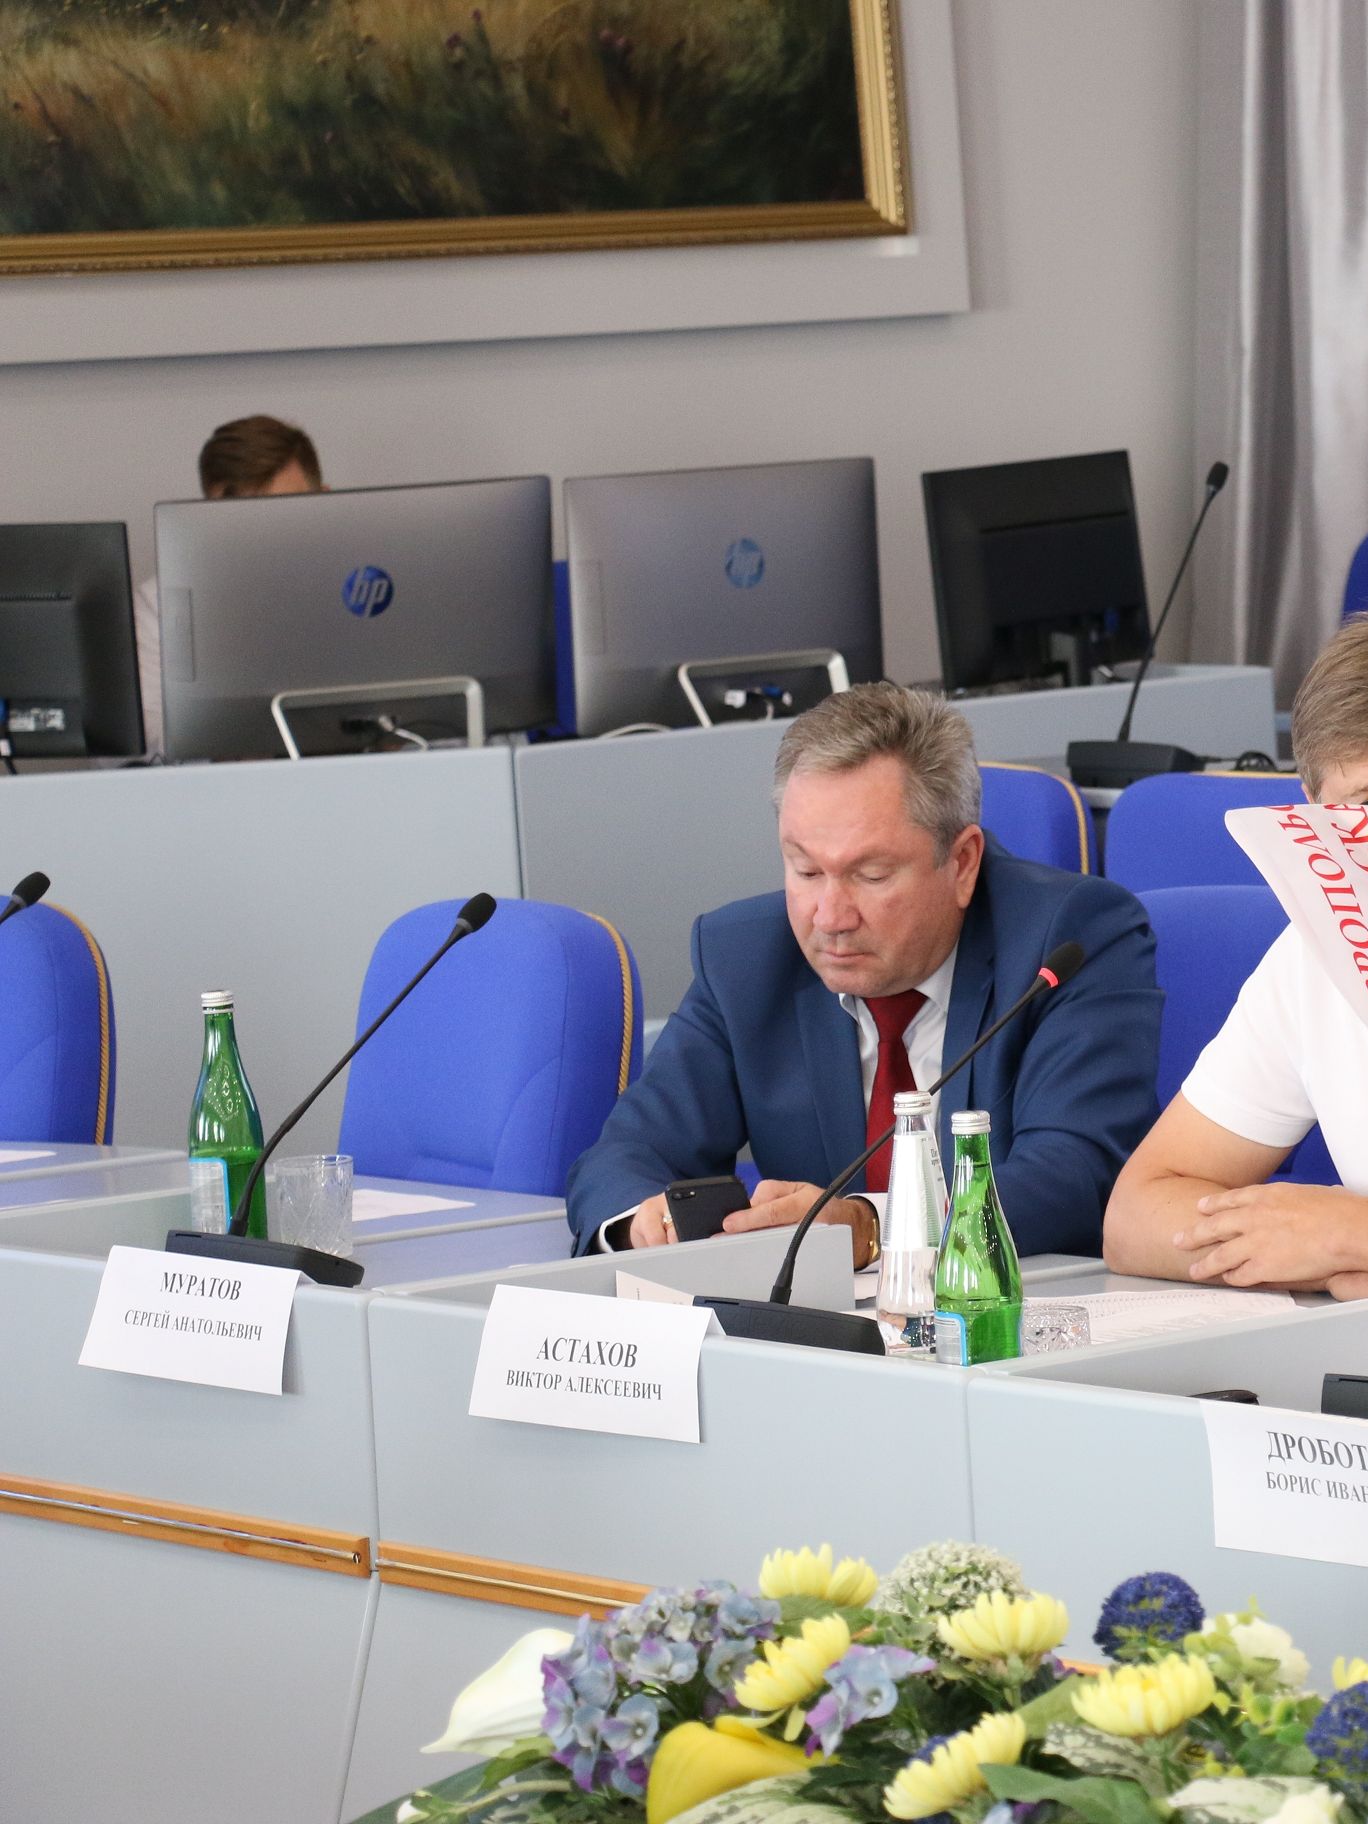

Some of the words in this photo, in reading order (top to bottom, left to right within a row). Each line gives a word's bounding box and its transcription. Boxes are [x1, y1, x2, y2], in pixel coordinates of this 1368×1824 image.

[346, 566, 393, 618] hp
[159, 1271, 242, 1301] МУРАТОВ
[124, 1308, 170, 1330] СЕРГЕЙ
[172, 1314, 263, 1342] АНАТОЛЬЕВИЧ
[536, 1337, 638, 1369] АСТАХОВ
[506, 1369, 562, 1391] ВИКТОР
[564, 1374, 662, 1401] АЛЕКСЕЕВИЧ
[1266, 1471, 1322, 1496] БОРИС
